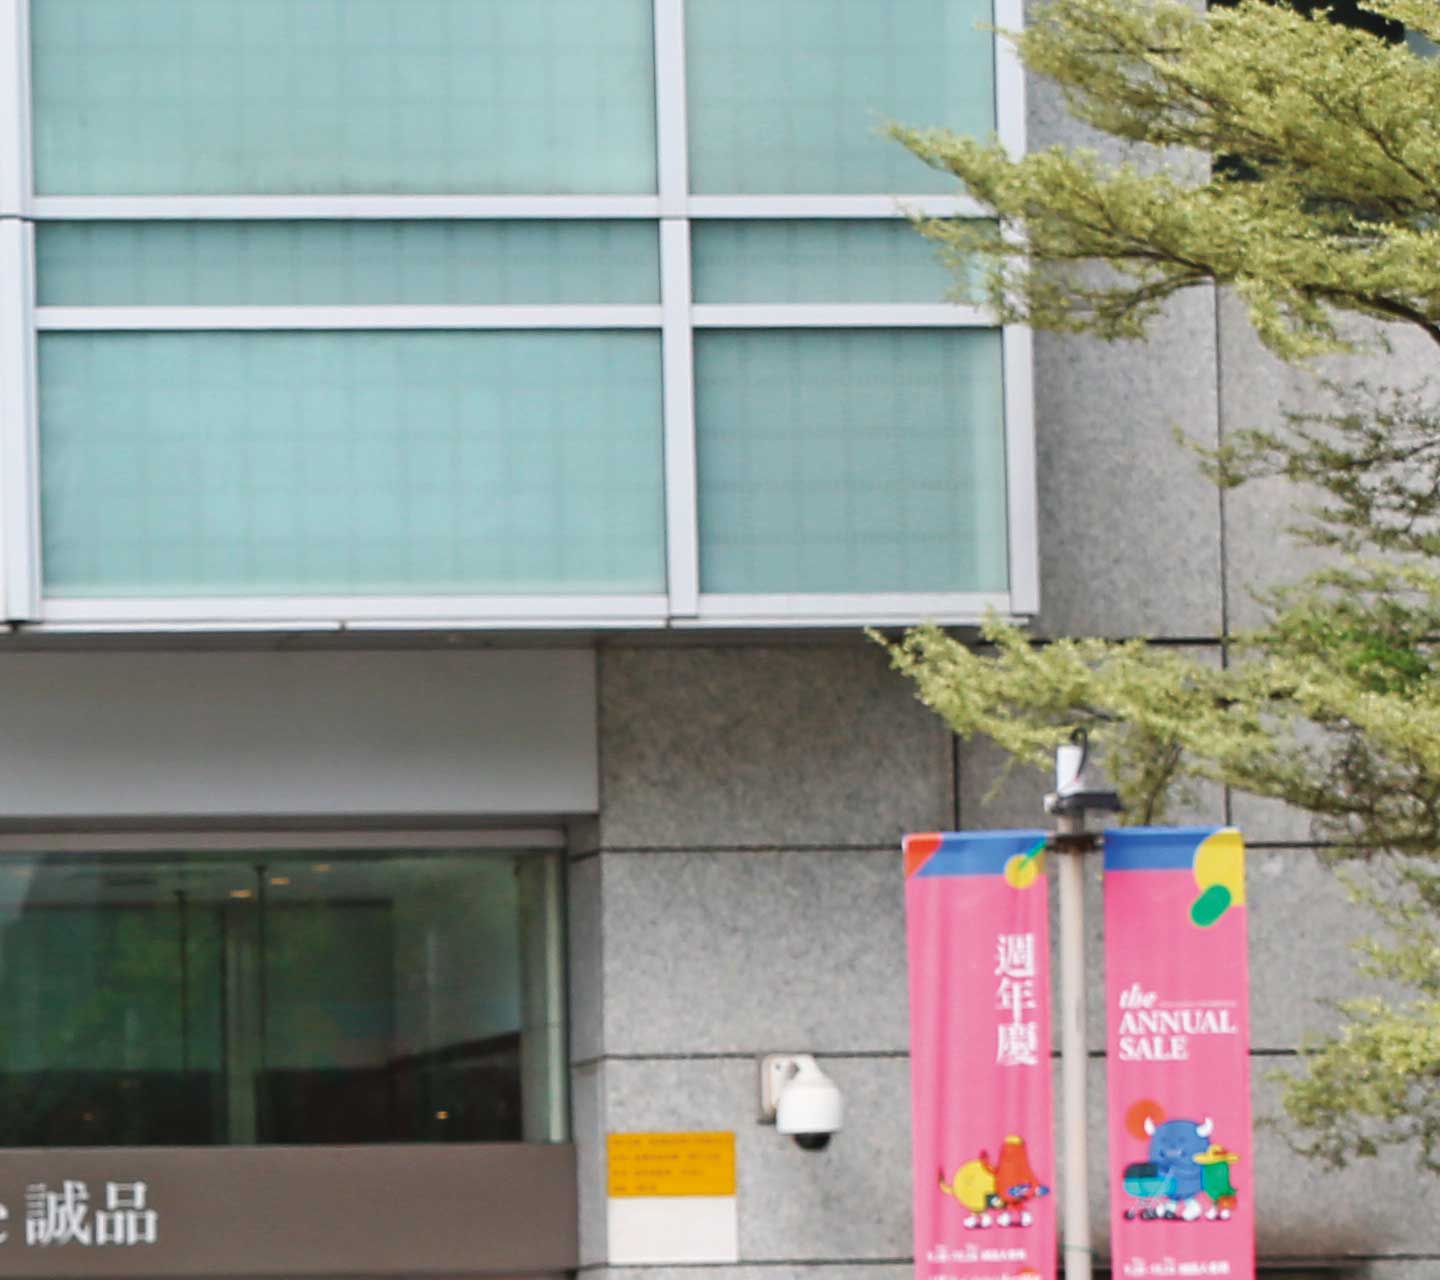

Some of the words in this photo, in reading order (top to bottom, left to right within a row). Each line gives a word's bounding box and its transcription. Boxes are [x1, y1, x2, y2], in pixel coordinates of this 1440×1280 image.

[994, 932, 1038, 1066] 週年慶
[1119, 982, 1158, 1009] the
[1118, 1009, 1239, 1035] ANNUAL
[1119, 1035, 1189, 1061] SALE
[25, 1180, 157, 1247] 誠品
